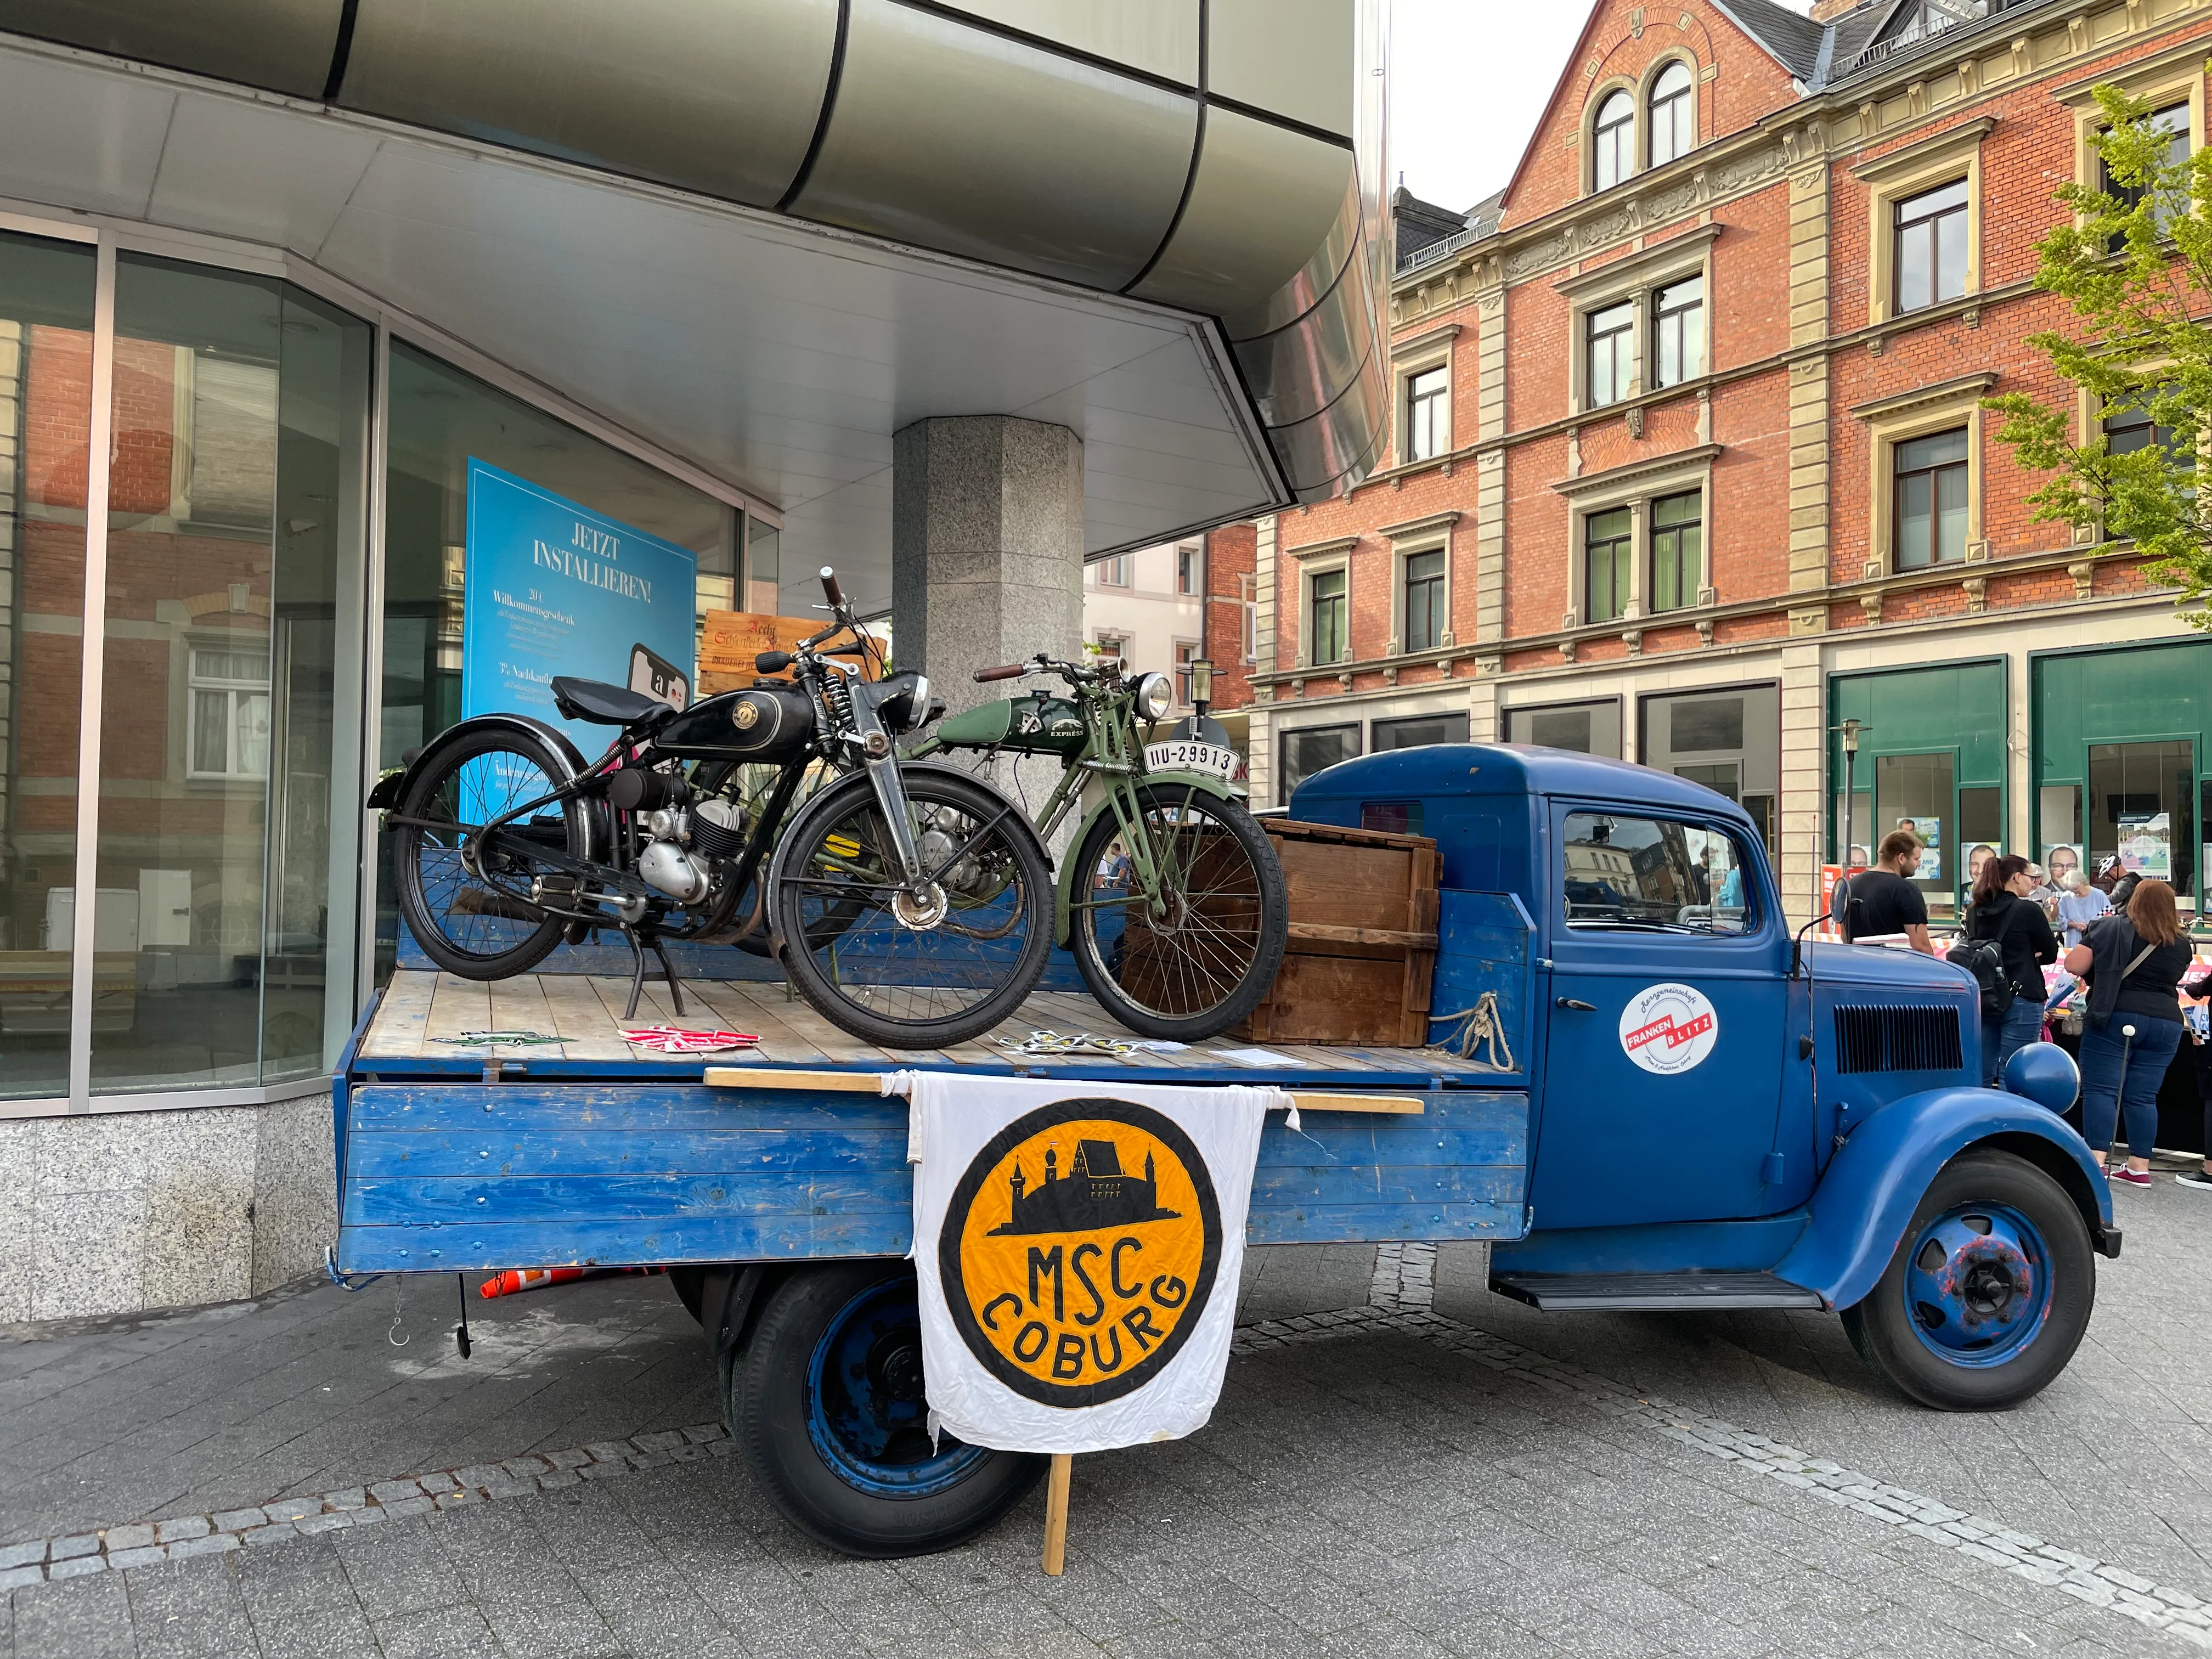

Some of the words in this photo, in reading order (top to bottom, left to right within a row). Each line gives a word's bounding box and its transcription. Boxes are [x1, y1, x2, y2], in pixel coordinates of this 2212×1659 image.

[572, 522, 620, 561] JETZT
[533, 539, 652, 603] INSTALLIEREN!
[493, 589, 575, 626] Willkommensgeschenk
[528, 588, 538, 601] 20
[712, 656, 744, 666] BRAUEREI
[1150, 746, 1231, 770] IIU-29913
[1640, 986, 1697, 1013] Renngemeinschaft
[1627, 1019, 1672, 1048] FRANKEN
[1667, 1018, 1709, 1046] BLITZ
[1028, 1237, 1143, 1327] MSC
[982, 1273, 1187, 1380] COBURG
